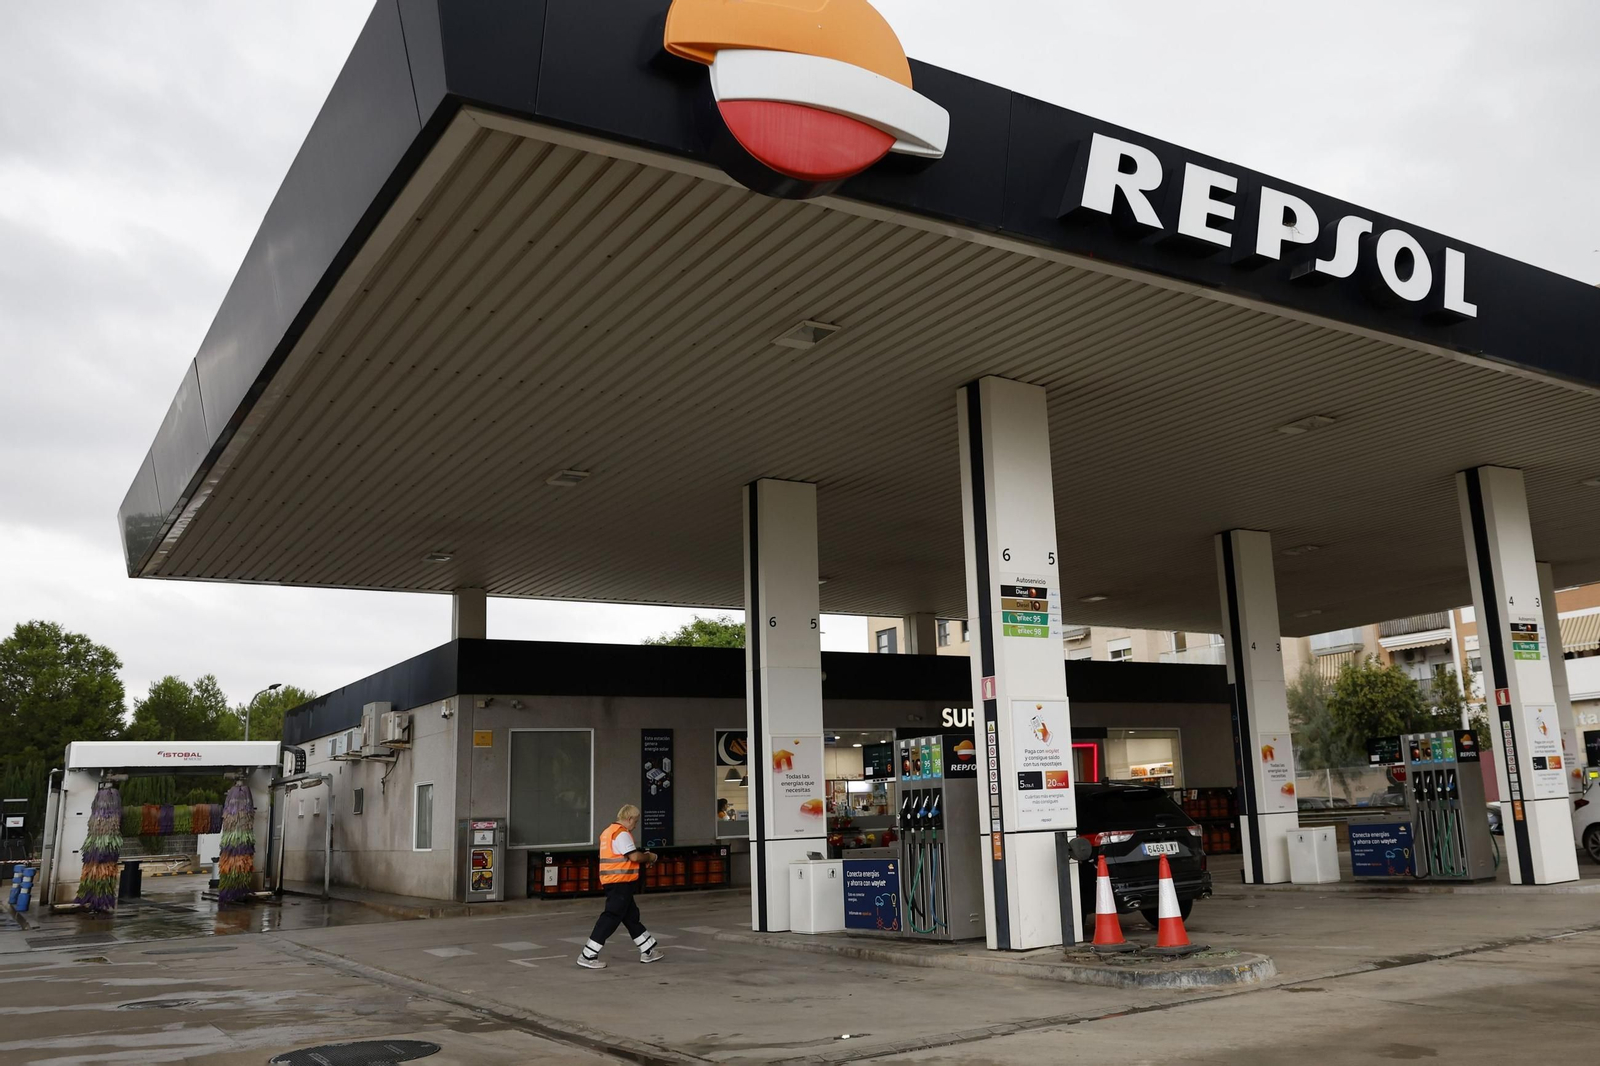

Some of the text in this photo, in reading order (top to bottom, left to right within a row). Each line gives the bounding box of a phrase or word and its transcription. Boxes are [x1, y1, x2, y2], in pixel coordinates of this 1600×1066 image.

[1081, 132, 1477, 317] REPSOL
[1003, 548, 1011, 561] 6
[1048, 552, 1055, 565] 5
[1016, 577, 1046, 585] Autoservicio
[1509, 596, 1514, 606] 4
[1535, 597, 1540, 607] 3
[769, 616, 777, 628] 6
[810, 618, 817, 629] 5
[1251, 642, 1256, 650] 4
[1276, 643, 1281, 651] 3
[1148, 844, 1164, 853] 6469
[863, 870, 880, 879] energías
